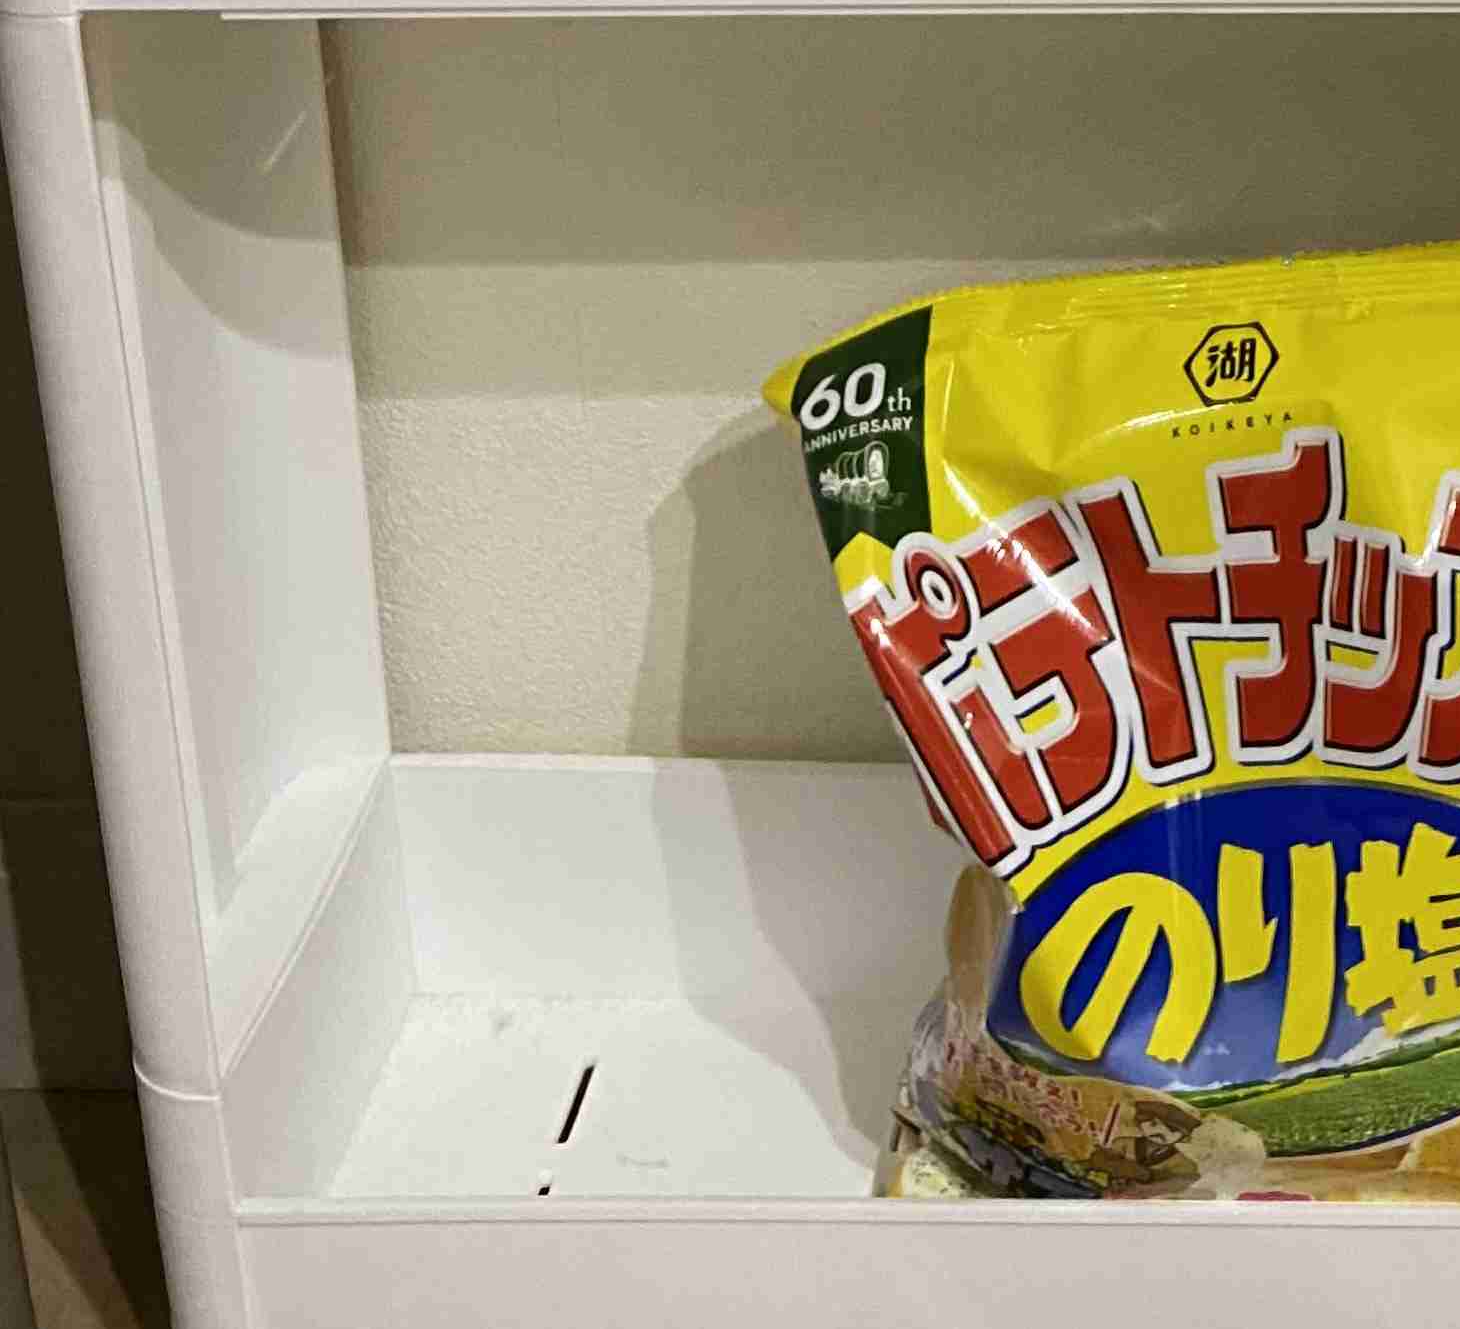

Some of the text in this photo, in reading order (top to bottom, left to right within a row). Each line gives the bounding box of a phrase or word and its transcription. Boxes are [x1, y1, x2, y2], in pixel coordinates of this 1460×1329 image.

[1204, 336, 1257, 388] 湖
[800, 361, 912, 431] 60th
[1171, 411, 1294, 439] KOIKEYA
